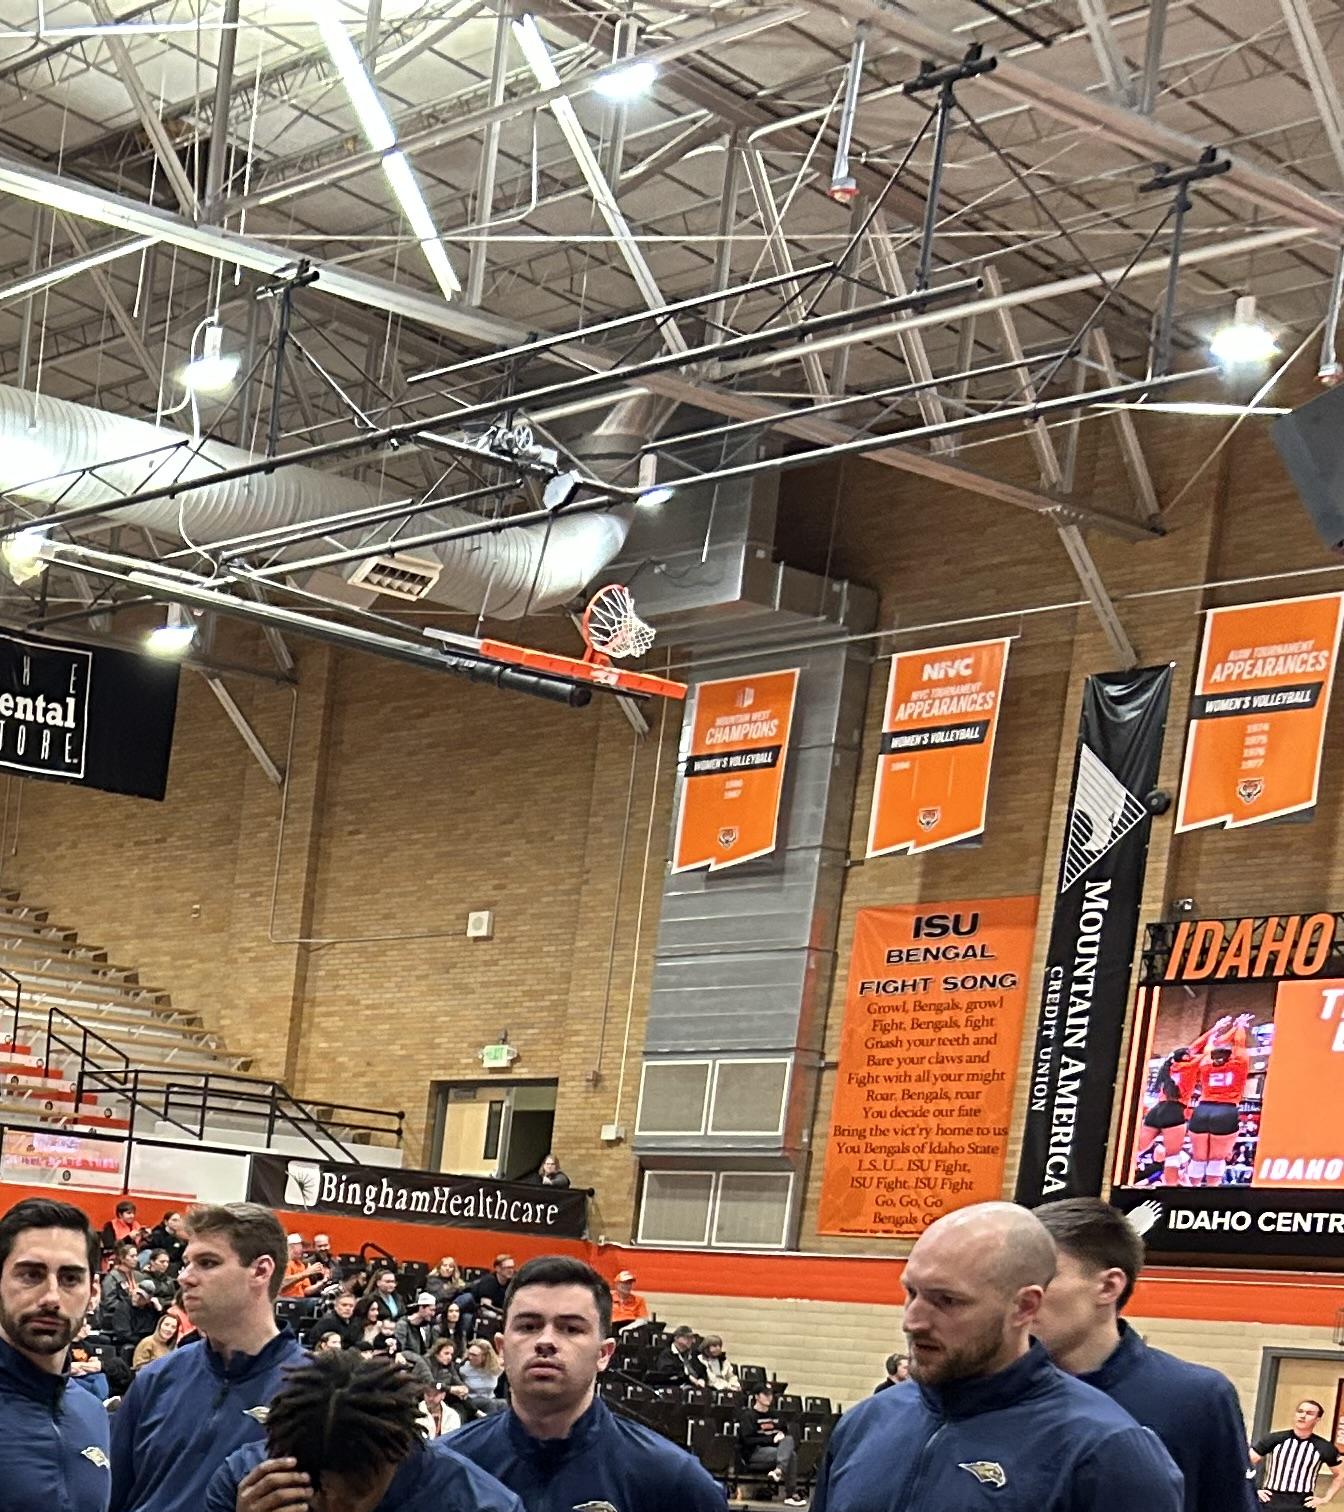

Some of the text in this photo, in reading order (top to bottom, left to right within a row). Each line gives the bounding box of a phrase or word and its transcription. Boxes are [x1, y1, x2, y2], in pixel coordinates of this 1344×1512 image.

[1209, 650, 1329, 684] APPEARANCES
[895, 691, 995, 722] APPEARANCES
[1205, 688, 1312, 713] WOMEN'S VOLLEYBALL
[705, 719, 779, 746] CHAMPIONS
[891, 726, 980, 749] WOMEN'S VOLLEYBALL
[729, 751, 773, 768] VOLLEYBALL
[913, 913, 980, 939] ISU
[886, 944, 996, 965] BENGAL
[1164, 912, 1336, 981] IDAHO
[859, 973, 1017, 996] FIGHT SONG
[966, 996, 1004, 1012] growl
[964, 1014, 995, 1031] fight
[864, 1032, 998, 1050] Gnash your teeth and
[1031, 965, 1063, 1112] CREDIT UNION
[1042, 878, 1112, 1196] MOUNTAIN AMERICA
[866, 1050, 990, 1069] Bare your claws and
[847, 1069, 1006, 1087] Fight with all your might
[954, 1090, 982, 1100] roar
[863, 1105, 982, 1119] You decide our fate
[833, 1125, 866, 1140] Bring
[869, 1125, 890, 1137] the
[935, 1124, 973, 1136] home
[976, 1126, 990, 1136] to
[836, 1142, 1000, 1157] You Bengals of Idaho State
[906, 1159, 932, 1171] ISU
[1259, 1157, 1344, 1182] IDAHO
[850, 1177, 874, 1189] ISU
[914, 1177, 938, 1190] ISU
[940, 1178, 974, 1193] Fight
[321, 1171, 560, 1226] BinghamHealthcare
[923, 1195, 943, 1208] Go
[872, 1212, 918, 1227] Bengals
[1168, 1209, 1251, 1231] IDAHO
